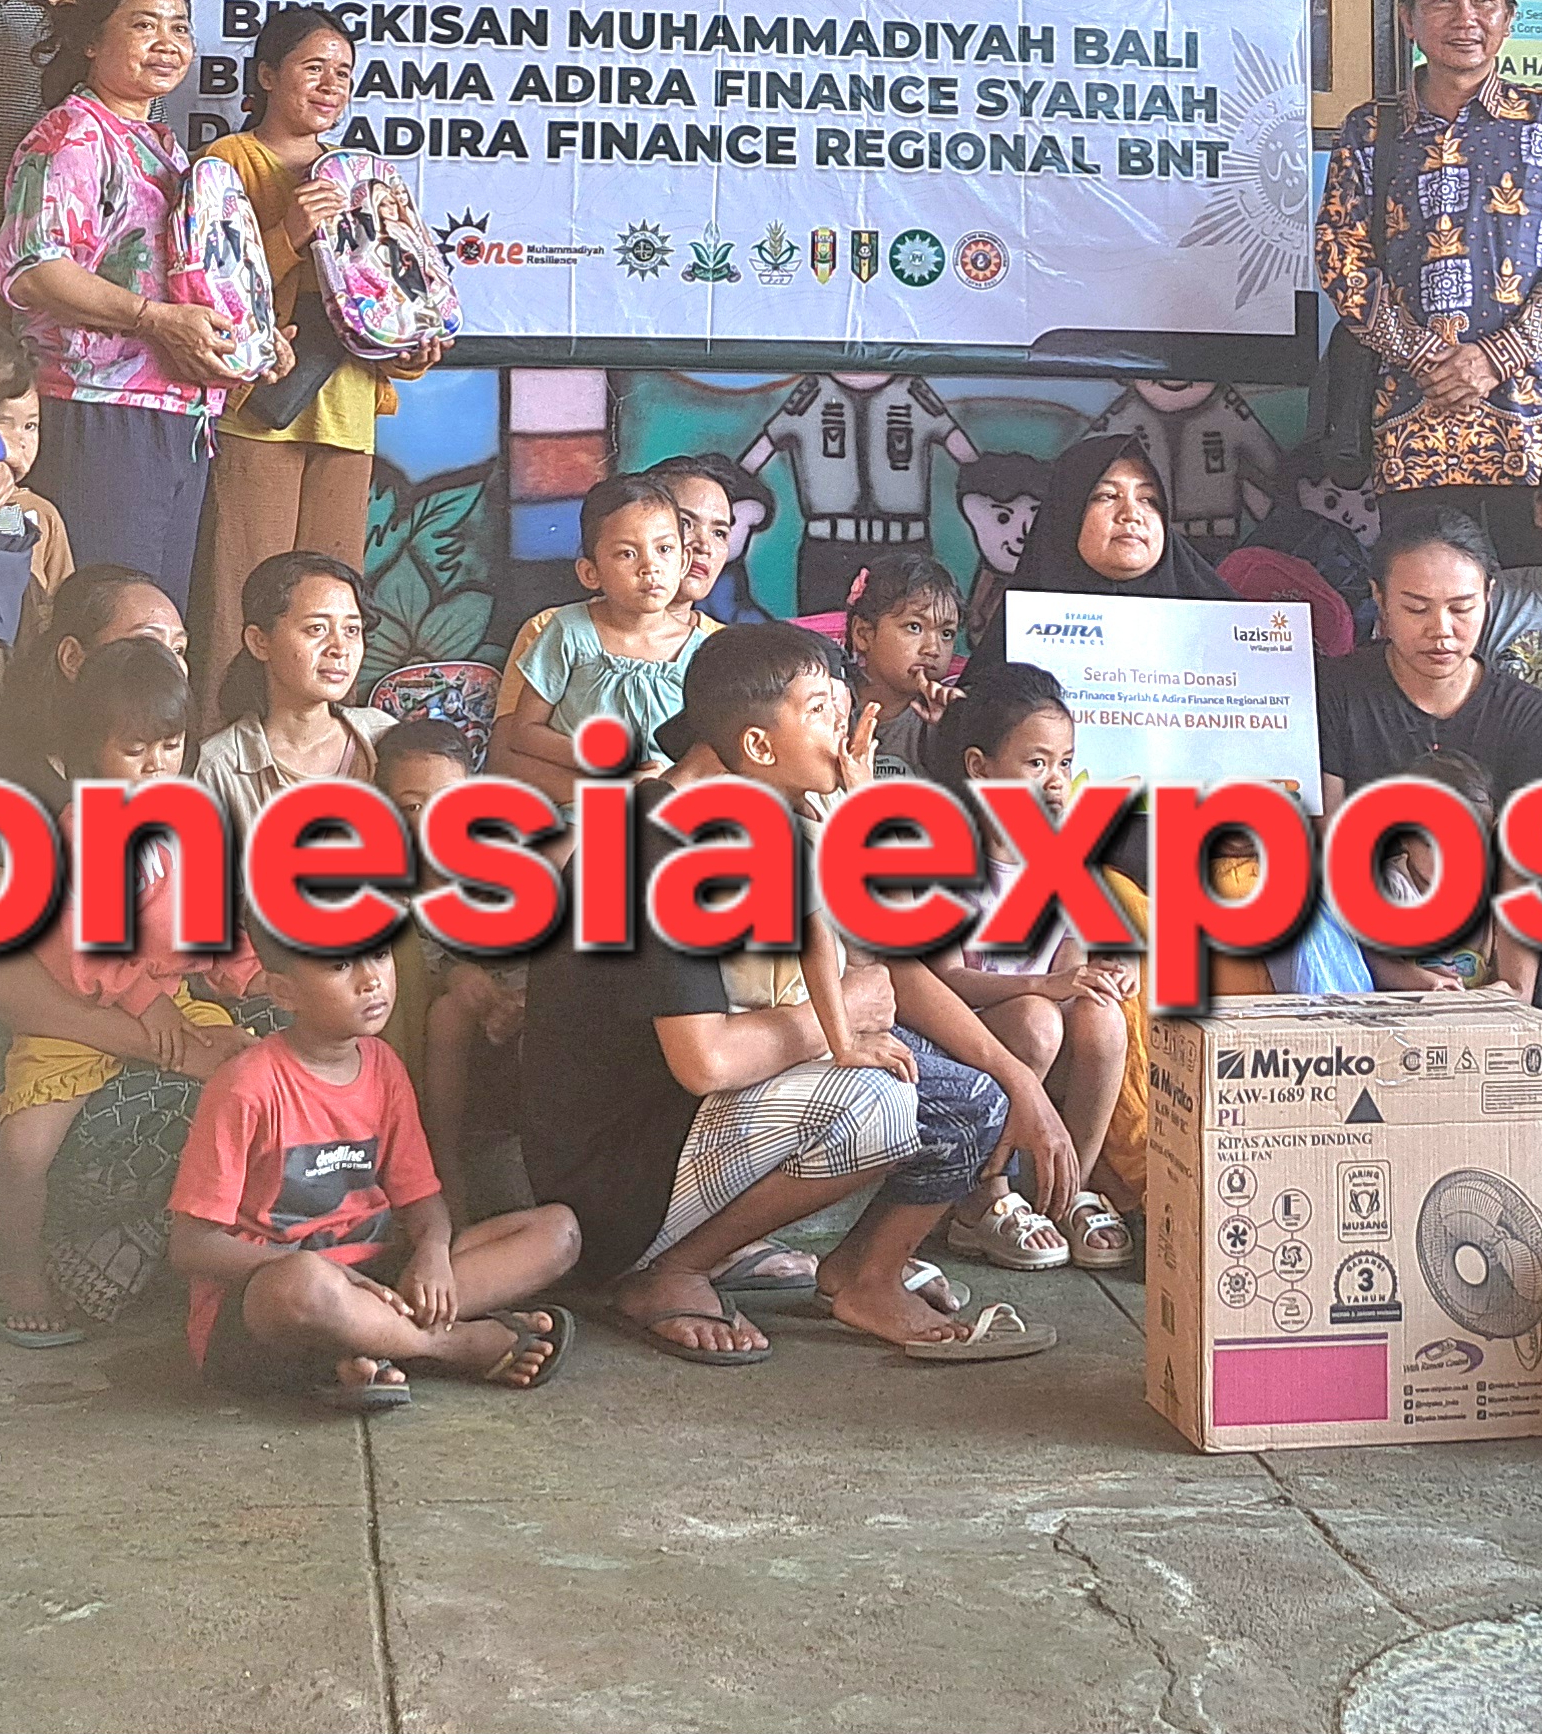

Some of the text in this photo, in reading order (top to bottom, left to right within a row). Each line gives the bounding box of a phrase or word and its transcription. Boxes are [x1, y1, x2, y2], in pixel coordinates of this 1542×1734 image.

[222, 0, 1199, 69] BGKISAN MUHAMMADIYAH BALI
[199, 55, 1219, 124] BAMA ADIRA FINANCE SYARIAH
[340, 117, 1230, 179] ADIRA FINANCE REGIONAL BNT
[527, 245, 605, 256] Muhammadiyah
[527, 255, 578, 266] Resilience
[1026, 623, 1104, 638] ADIRA
[1233, 626, 1293, 643] lazismu
[1084, 667, 1237, 687] Serah Terima Donasi
[1079, 691, 1115, 702] Finance
[1117, 692, 1151, 704] Syariah
[1152, 694, 1159, 702] &
[1162, 693, 1186, 704] Adira
[1188, 695, 1224, 705] Finance
[1226, 695, 1267, 707] Regional
[1270, 696, 1290, 706] BNT
[1100, 711, 1179, 728] BENCANA
[1184, 714, 1247, 729] BANJIR
[1250, 715, 1288, 730] BALI
[1251, 1046, 1375, 1086] Miyako
[1426, 1050, 1447, 1066] SNI
[1218, 1086, 1338, 1105] KAW-1689 RC
[1217, 1108, 1246, 1127] PL
[1218, 1132, 1373, 1150] KIPAS ANGIN DINDING
[1217, 1150, 1272, 1162] WALL FAN
[1349, 1170, 1380, 1182] JARING
[1343, 1220, 1388, 1231] MUSANG
[1347, 1257, 1385, 1273] GARANSI
[1358, 1267, 1374, 1293] 3
[1347, 1295, 1386, 1304] TAHUN
